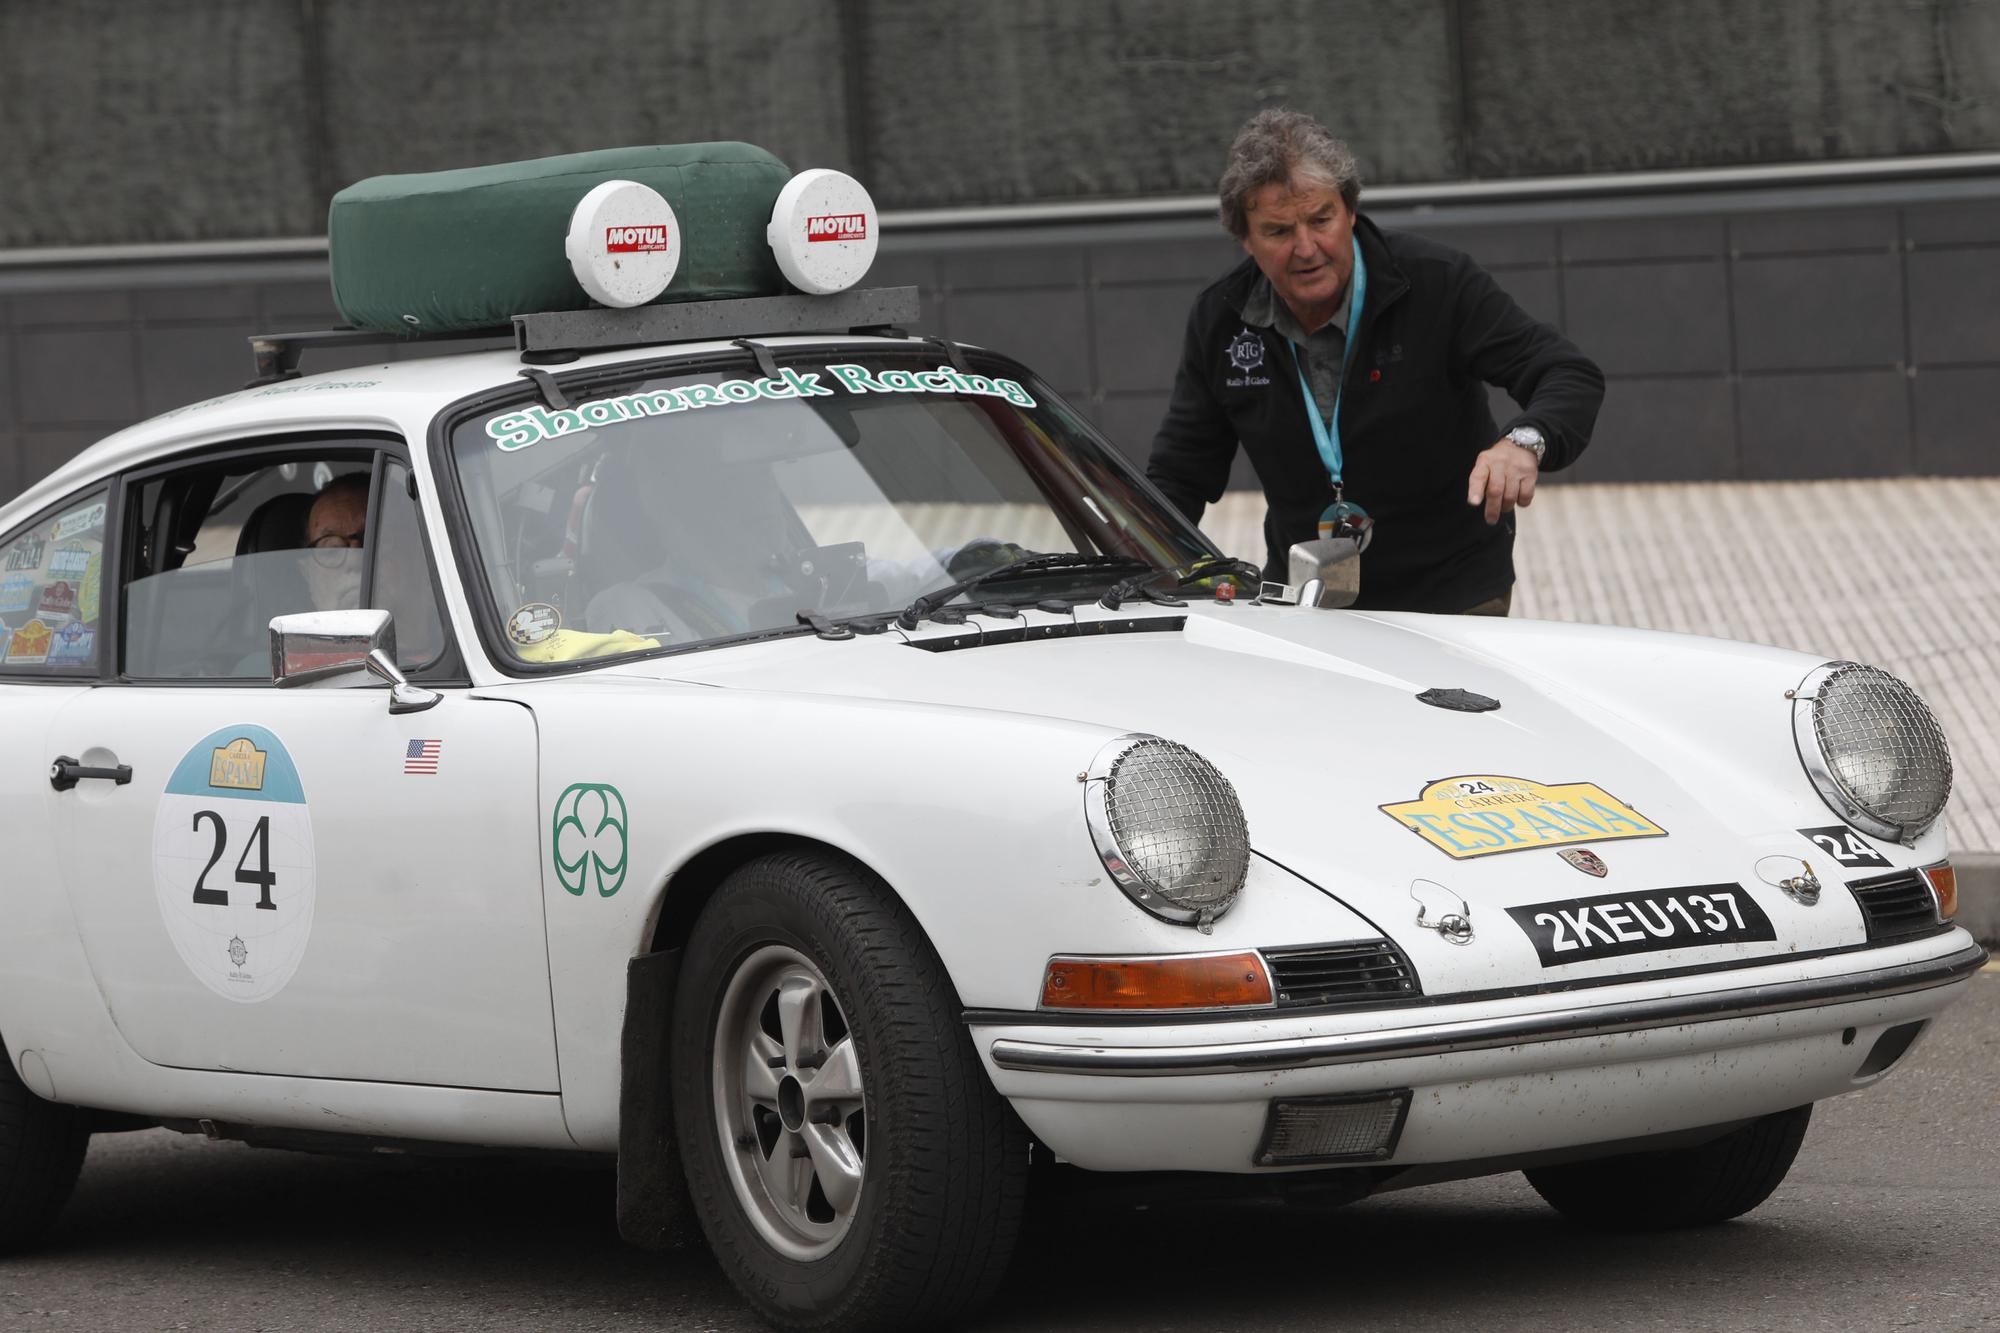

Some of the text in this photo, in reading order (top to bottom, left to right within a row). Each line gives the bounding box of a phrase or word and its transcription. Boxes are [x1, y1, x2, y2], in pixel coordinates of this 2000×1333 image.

[607, 228, 666, 245] MOTUL
[808, 216, 865, 235] MOTUL
[637, 243, 666, 251] LUBRICANTS
[485, 364, 1038, 452] Shamrock Racing
[1459, 781, 1495, 795] 24
[1455, 791, 1545, 810] CARRERA
[1404, 797, 1650, 851] ESPAÑA
[1812, 831, 1882, 861] 24
[192, 810, 277, 911] 24
[1534, 892, 1746, 953] 2KEU137
